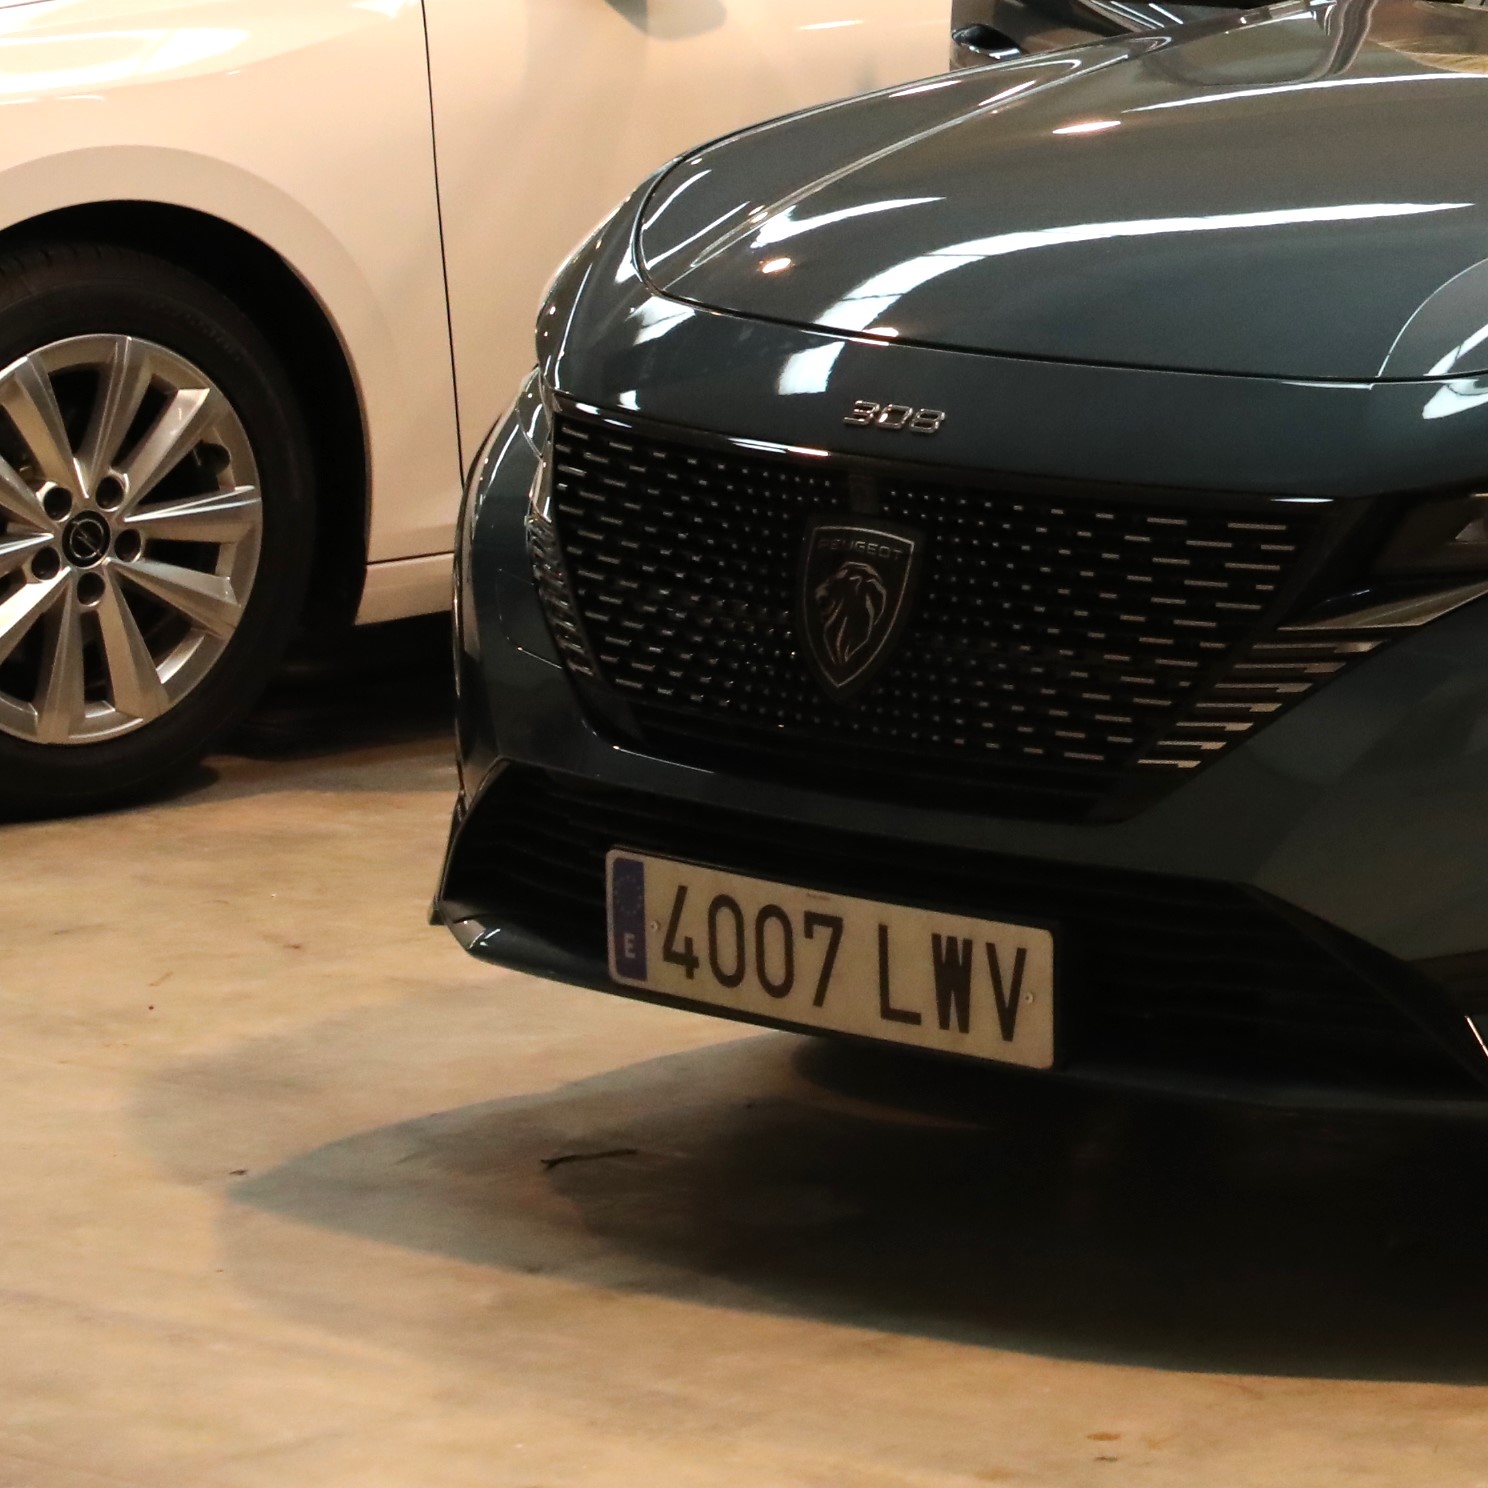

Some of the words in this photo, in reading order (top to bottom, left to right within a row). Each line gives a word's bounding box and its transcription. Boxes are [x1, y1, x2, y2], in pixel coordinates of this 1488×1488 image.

[843, 400, 946, 434] 308
[817, 537, 903, 561] PEUGEOT
[624, 933, 636, 959] E
[663, 885, 843, 1008] 4007
[878, 923, 1027, 1042] LWV
